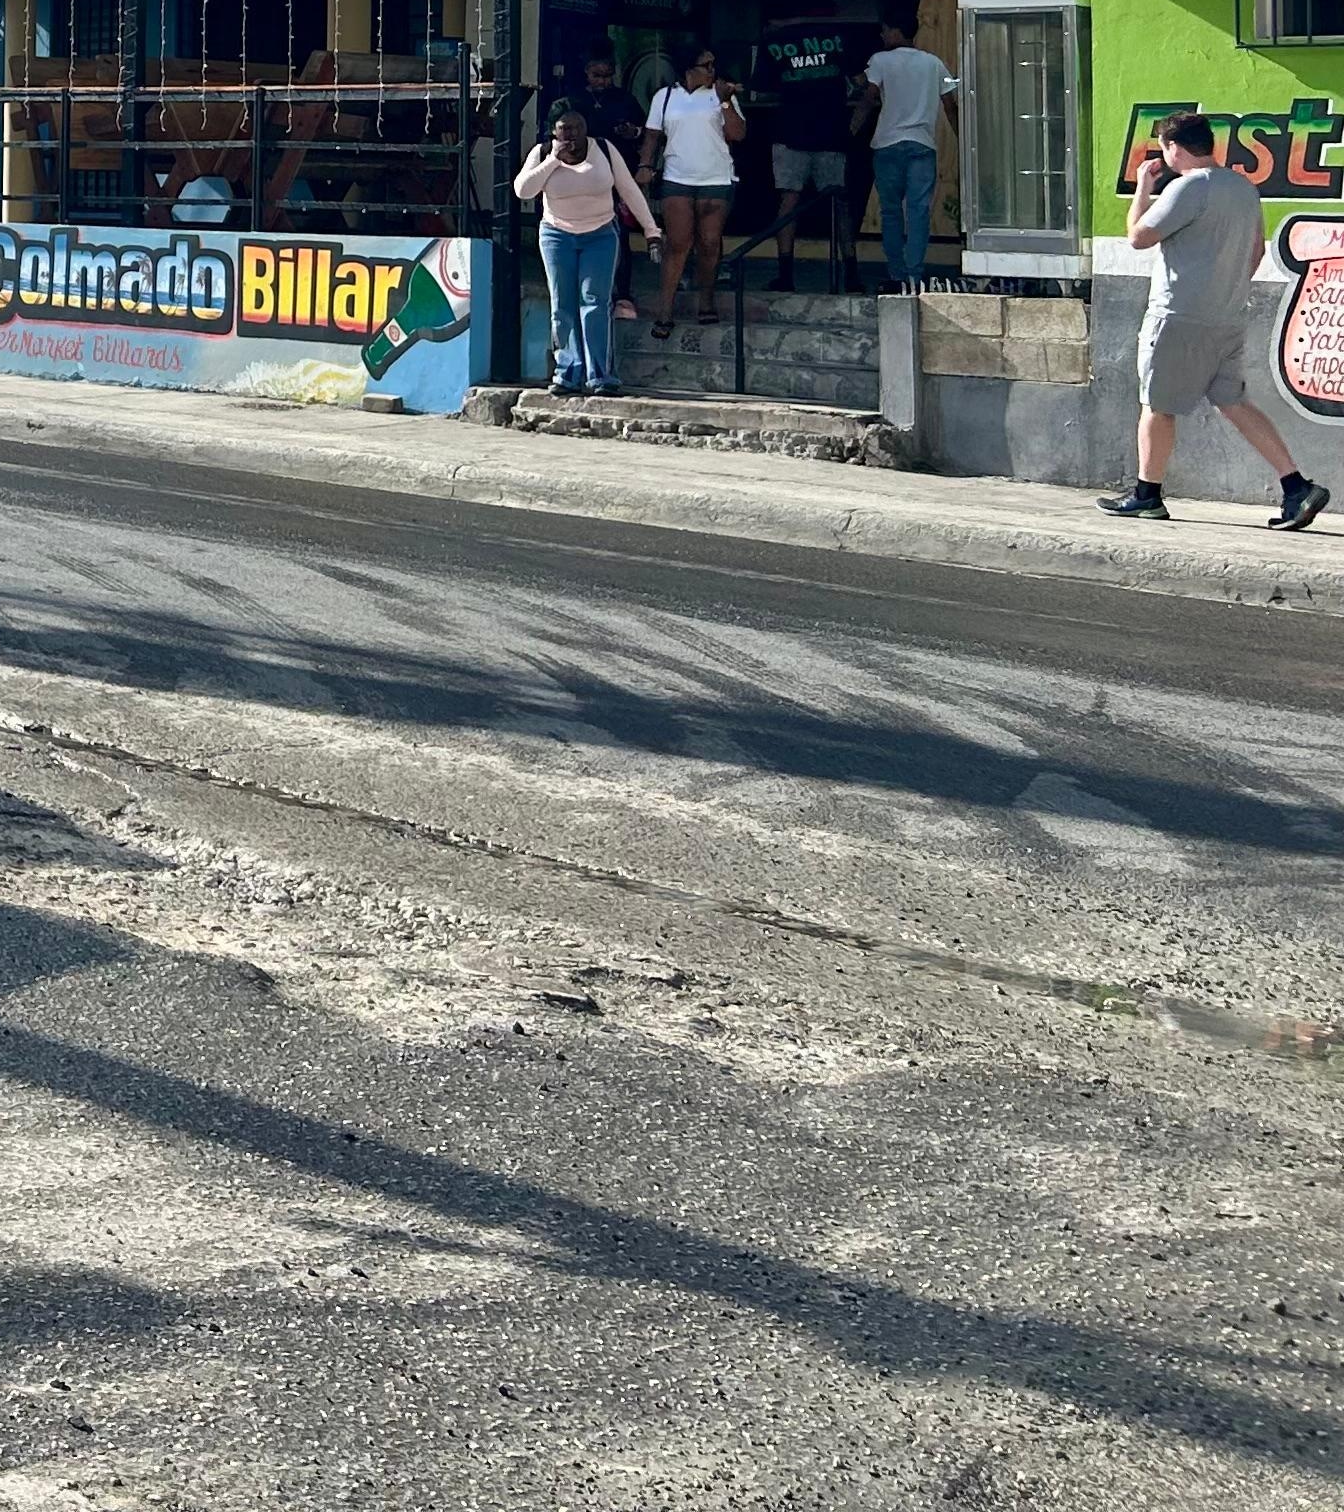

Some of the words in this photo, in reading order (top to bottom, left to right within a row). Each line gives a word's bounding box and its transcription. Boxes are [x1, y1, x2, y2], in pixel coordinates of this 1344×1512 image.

[768, 43, 799, 61] Do
[803, 35, 844, 54] Not
[790, 53, 827, 69] WAIT
[242, 244, 404, 336] Billar
